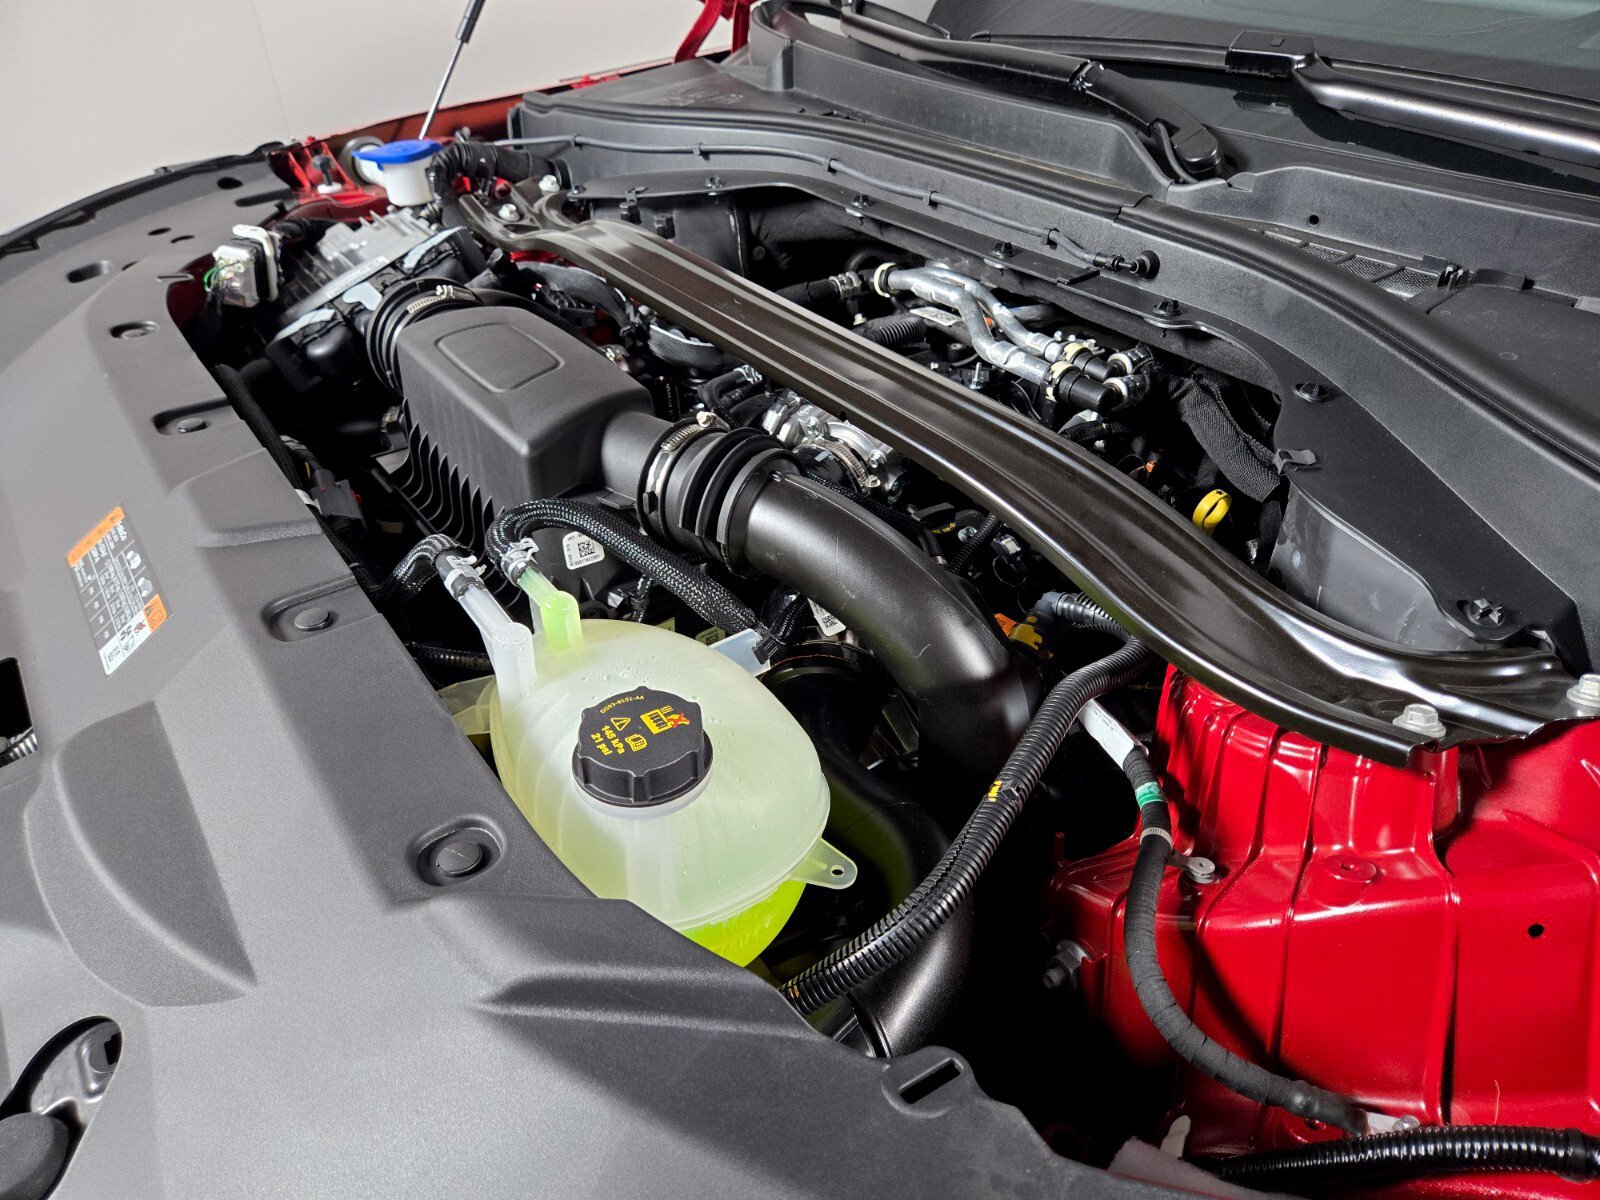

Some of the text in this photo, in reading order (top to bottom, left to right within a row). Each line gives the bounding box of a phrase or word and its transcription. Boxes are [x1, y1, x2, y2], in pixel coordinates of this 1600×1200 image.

[591, 732, 612, 755] 21 psi
[602, 725, 625, 754] 145 kPa
